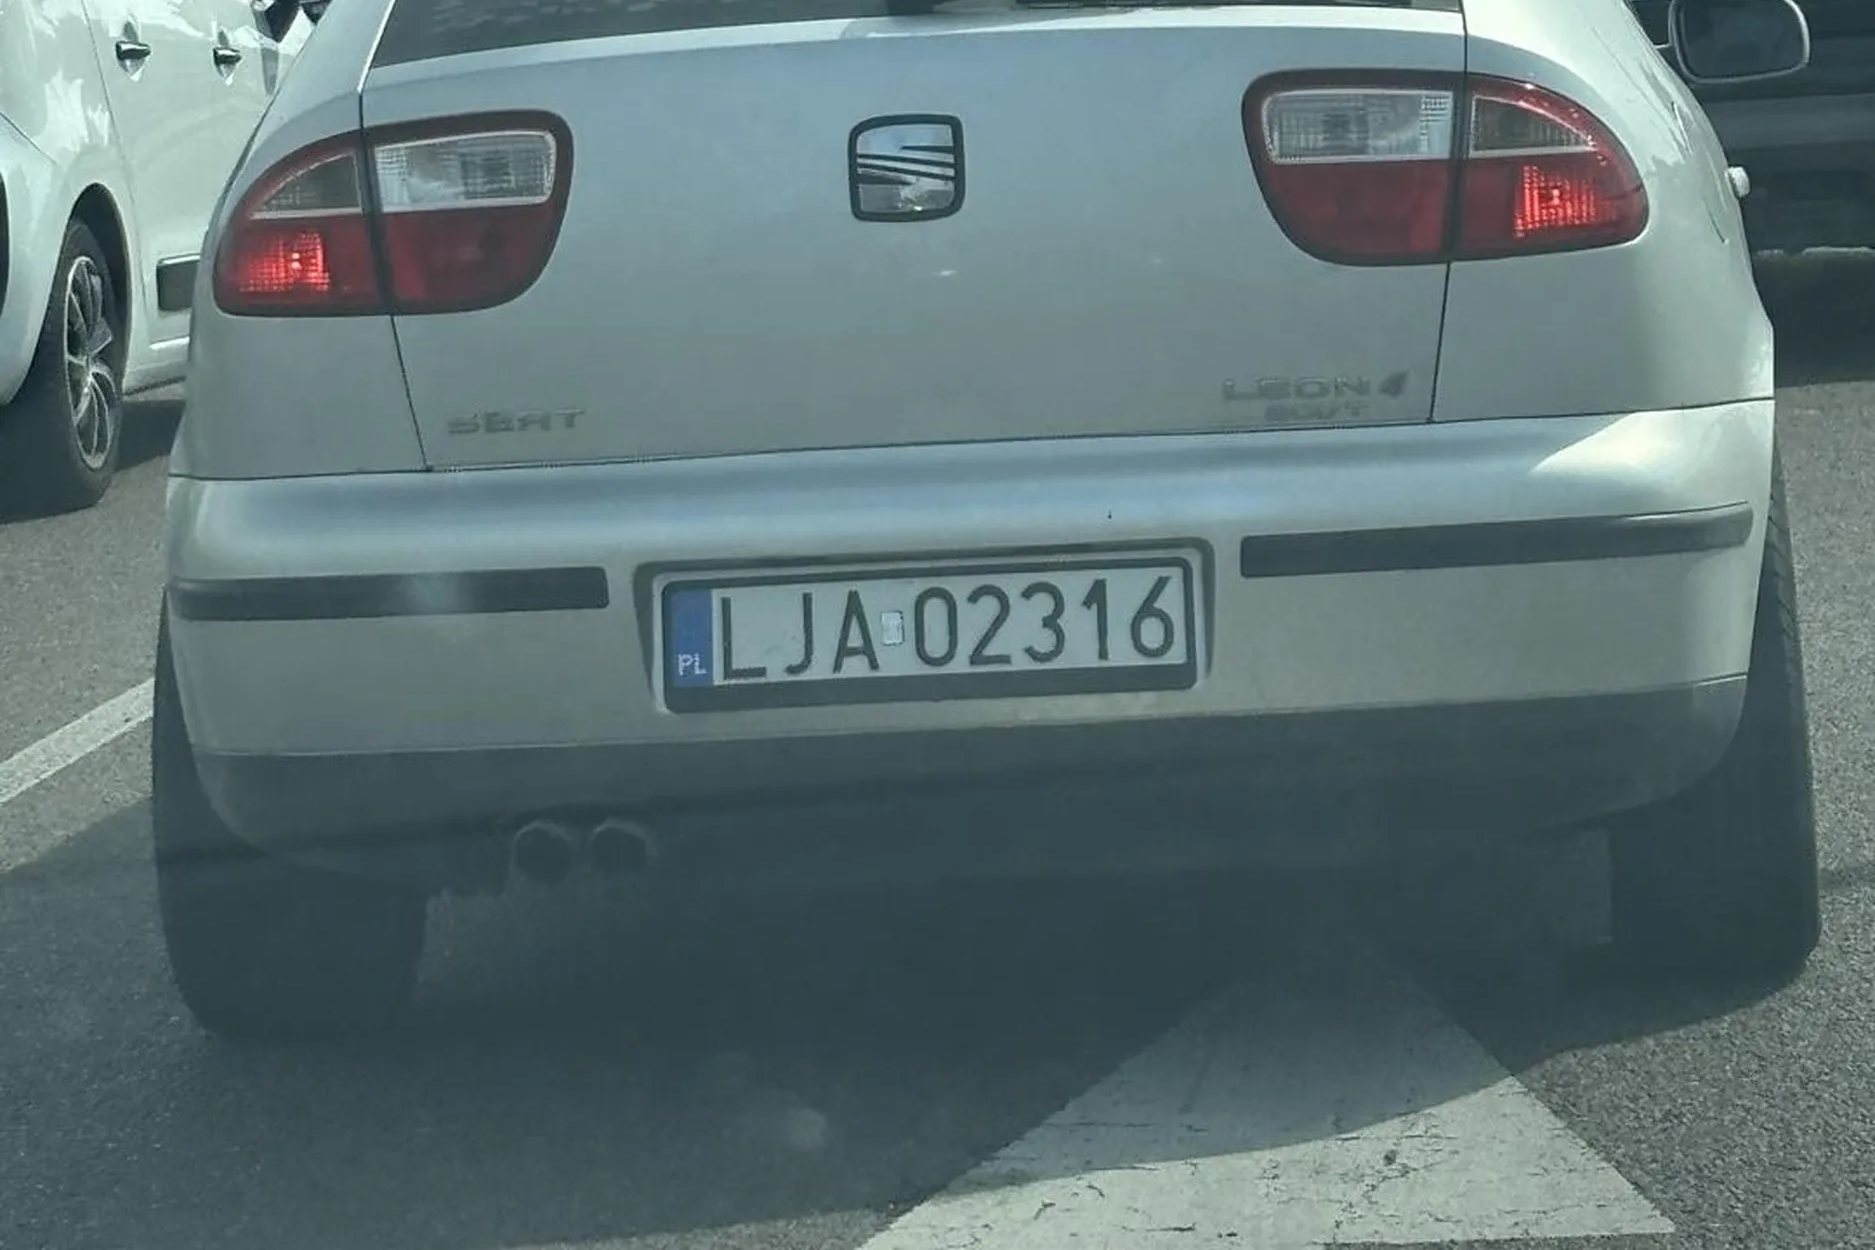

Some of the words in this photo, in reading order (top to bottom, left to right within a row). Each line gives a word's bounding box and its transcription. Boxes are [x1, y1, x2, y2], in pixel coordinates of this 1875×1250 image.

[1223, 376, 1370, 400] LEON
[448, 407, 585, 434] SEAT
[721, 590, 879, 680] LJA
[914, 576, 1173, 667] 02316
[678, 652, 707, 676] PL
